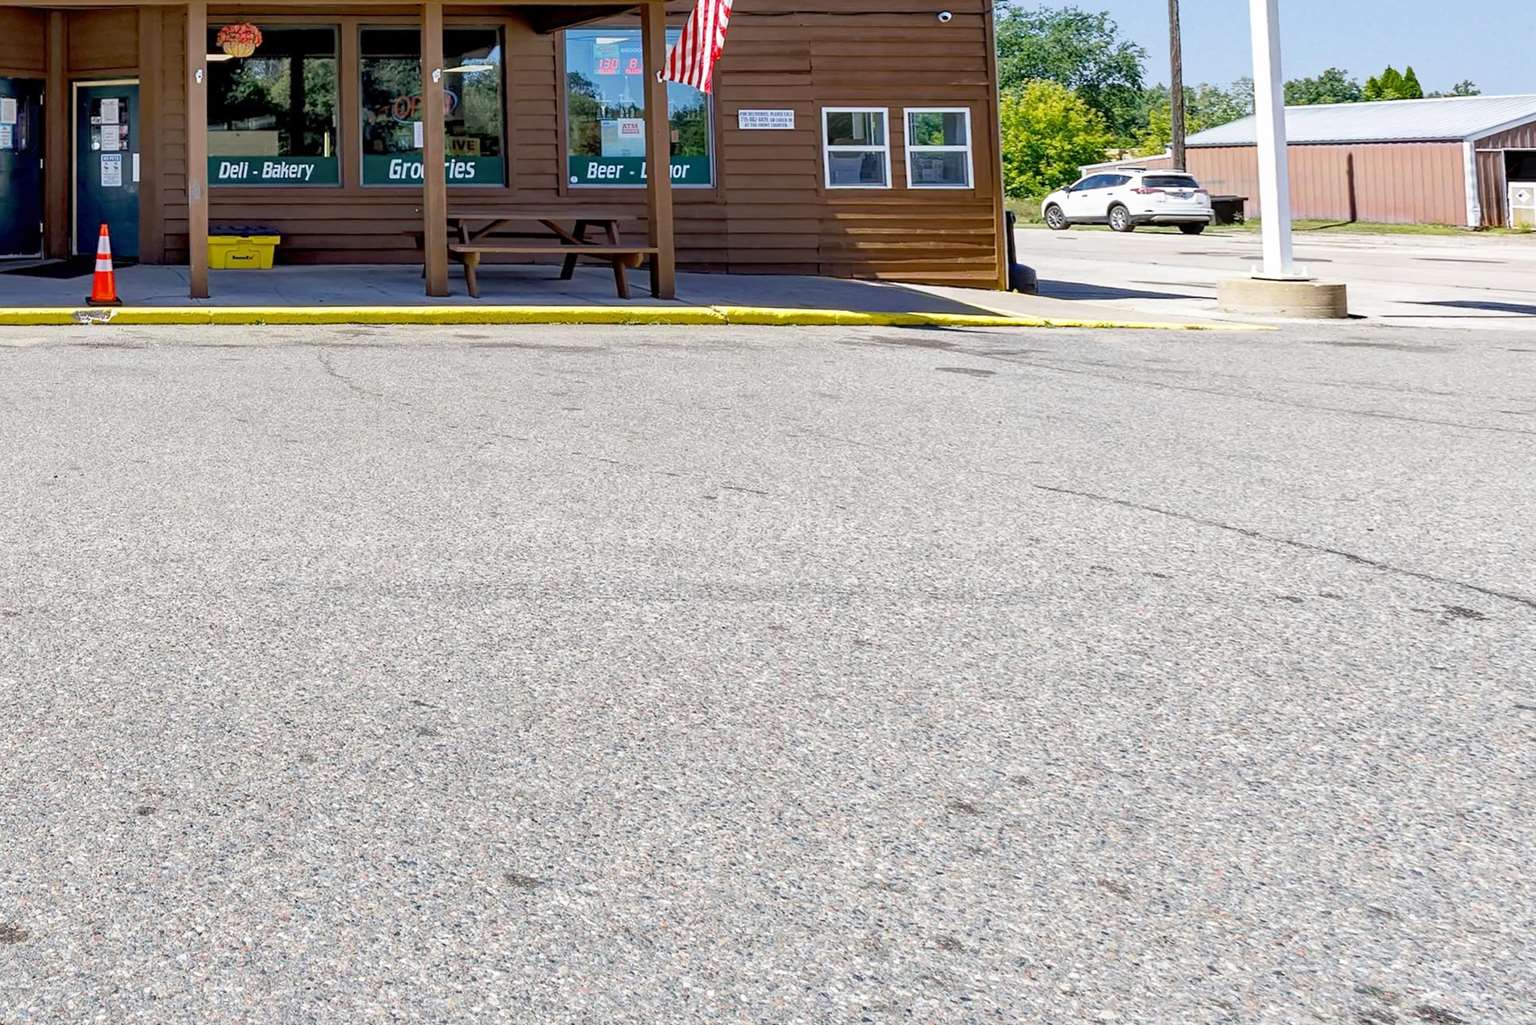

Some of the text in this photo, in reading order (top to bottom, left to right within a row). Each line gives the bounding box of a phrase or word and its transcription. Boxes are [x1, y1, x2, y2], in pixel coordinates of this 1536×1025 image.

[218, 161, 249, 179] Deli
[261, 161, 315, 181] Bakery
[388, 159, 476, 179] Groies
[586, 162, 624, 179] Beer
[640, 162, 690, 179] Lor
